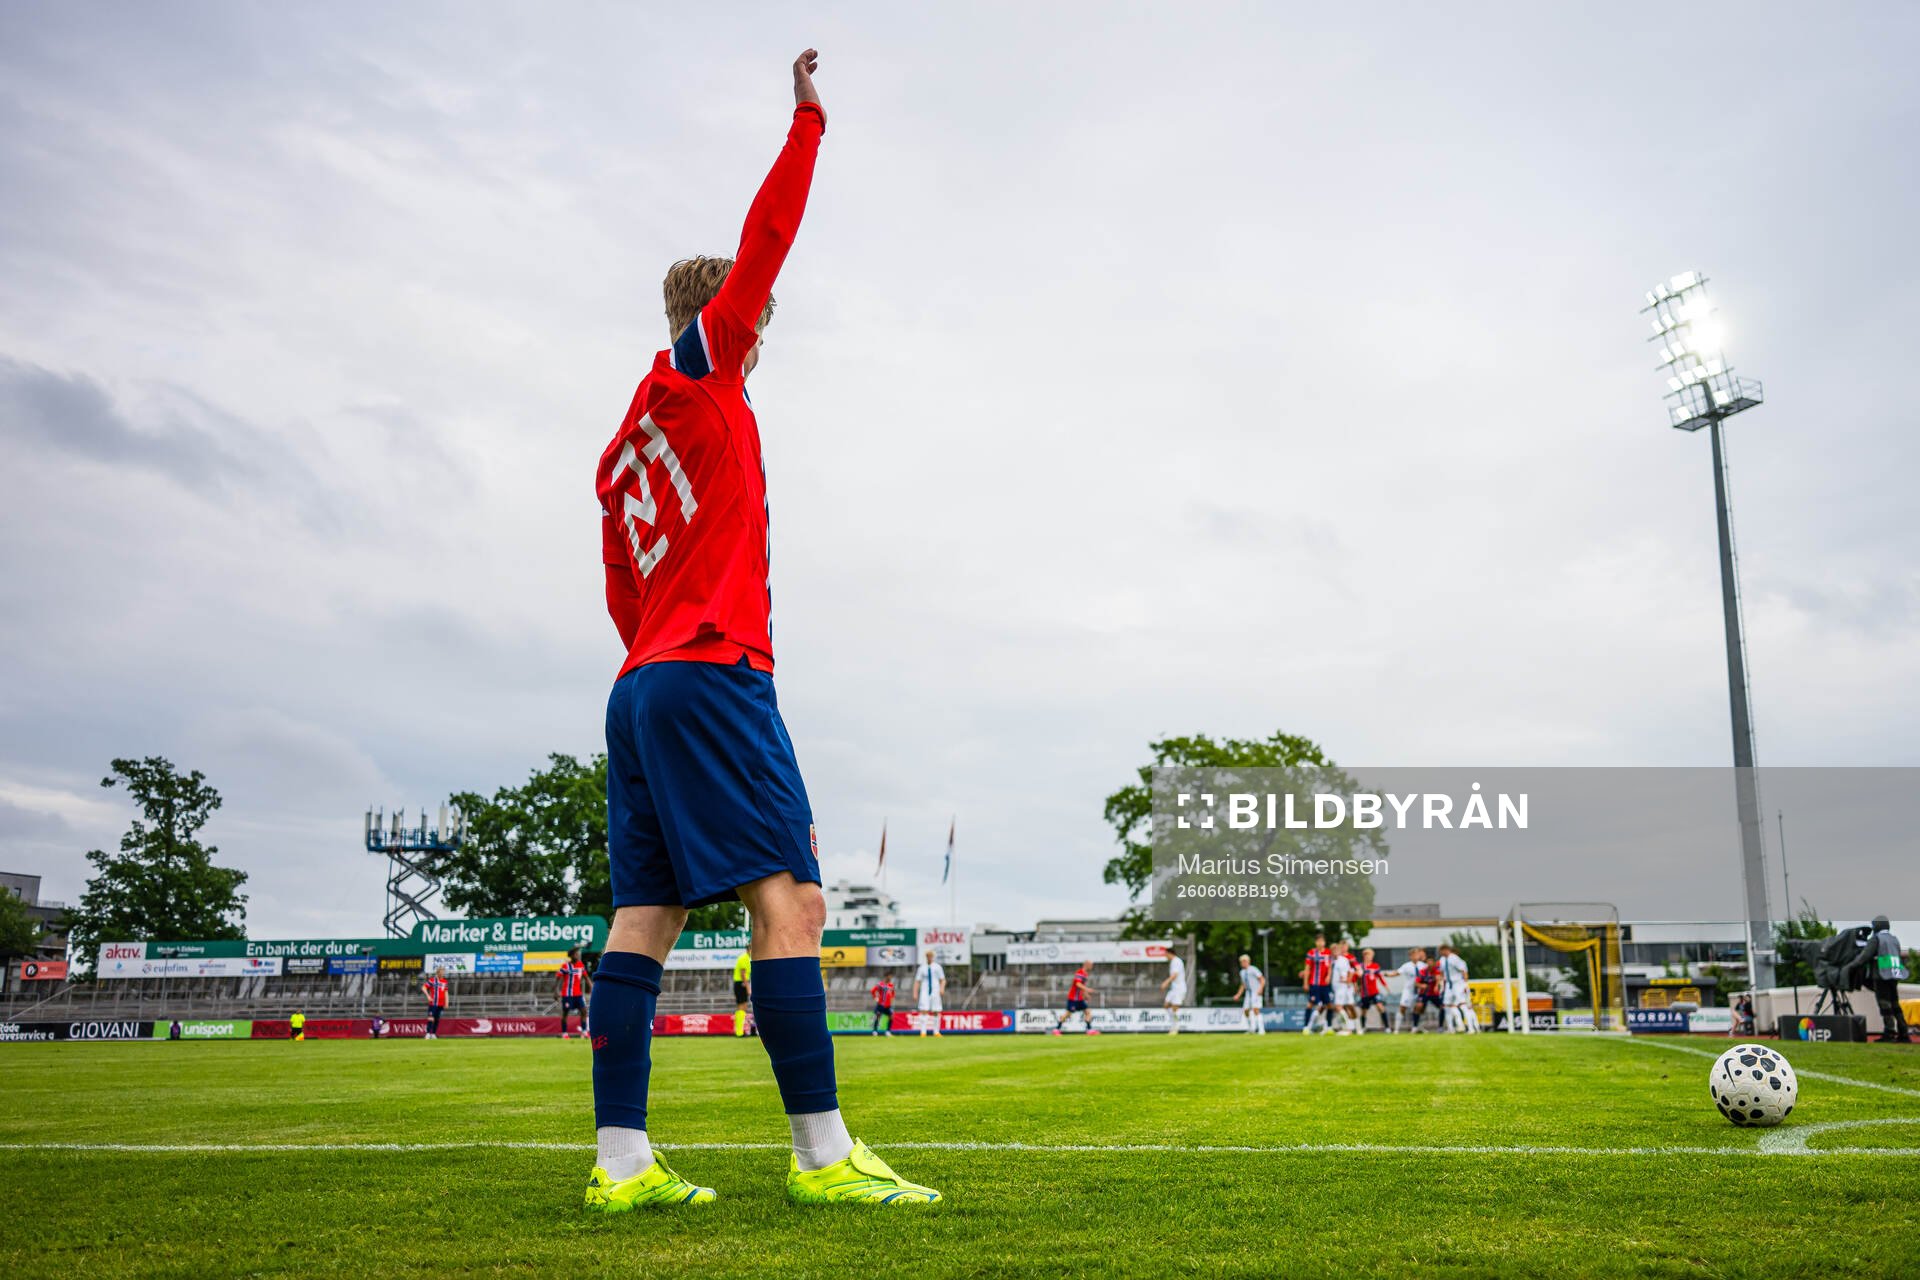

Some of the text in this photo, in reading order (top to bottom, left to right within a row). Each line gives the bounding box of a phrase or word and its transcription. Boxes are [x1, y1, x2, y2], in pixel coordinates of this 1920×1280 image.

[611, 411, 698, 579] 21
[422, 920, 594, 944] Marker & Eidsberg
[694, 932, 751, 948] En bank
[105, 944, 141, 959] aktiv.
[246, 940, 361, 956] En bank der du er
[484, 944, 528, 953] SPAREBANK
[153, 963, 188, 973] eurofins
[70, 1022, 139, 1038] GIOVANI
[184, 1022, 234, 1038] unisport
[496, 1022, 537, 1033] VIKING
[943, 1014, 983, 1030] TINE
[1514, 1015, 1556, 1029] SLECT
[1808, 1029, 1832, 1042] NEP
